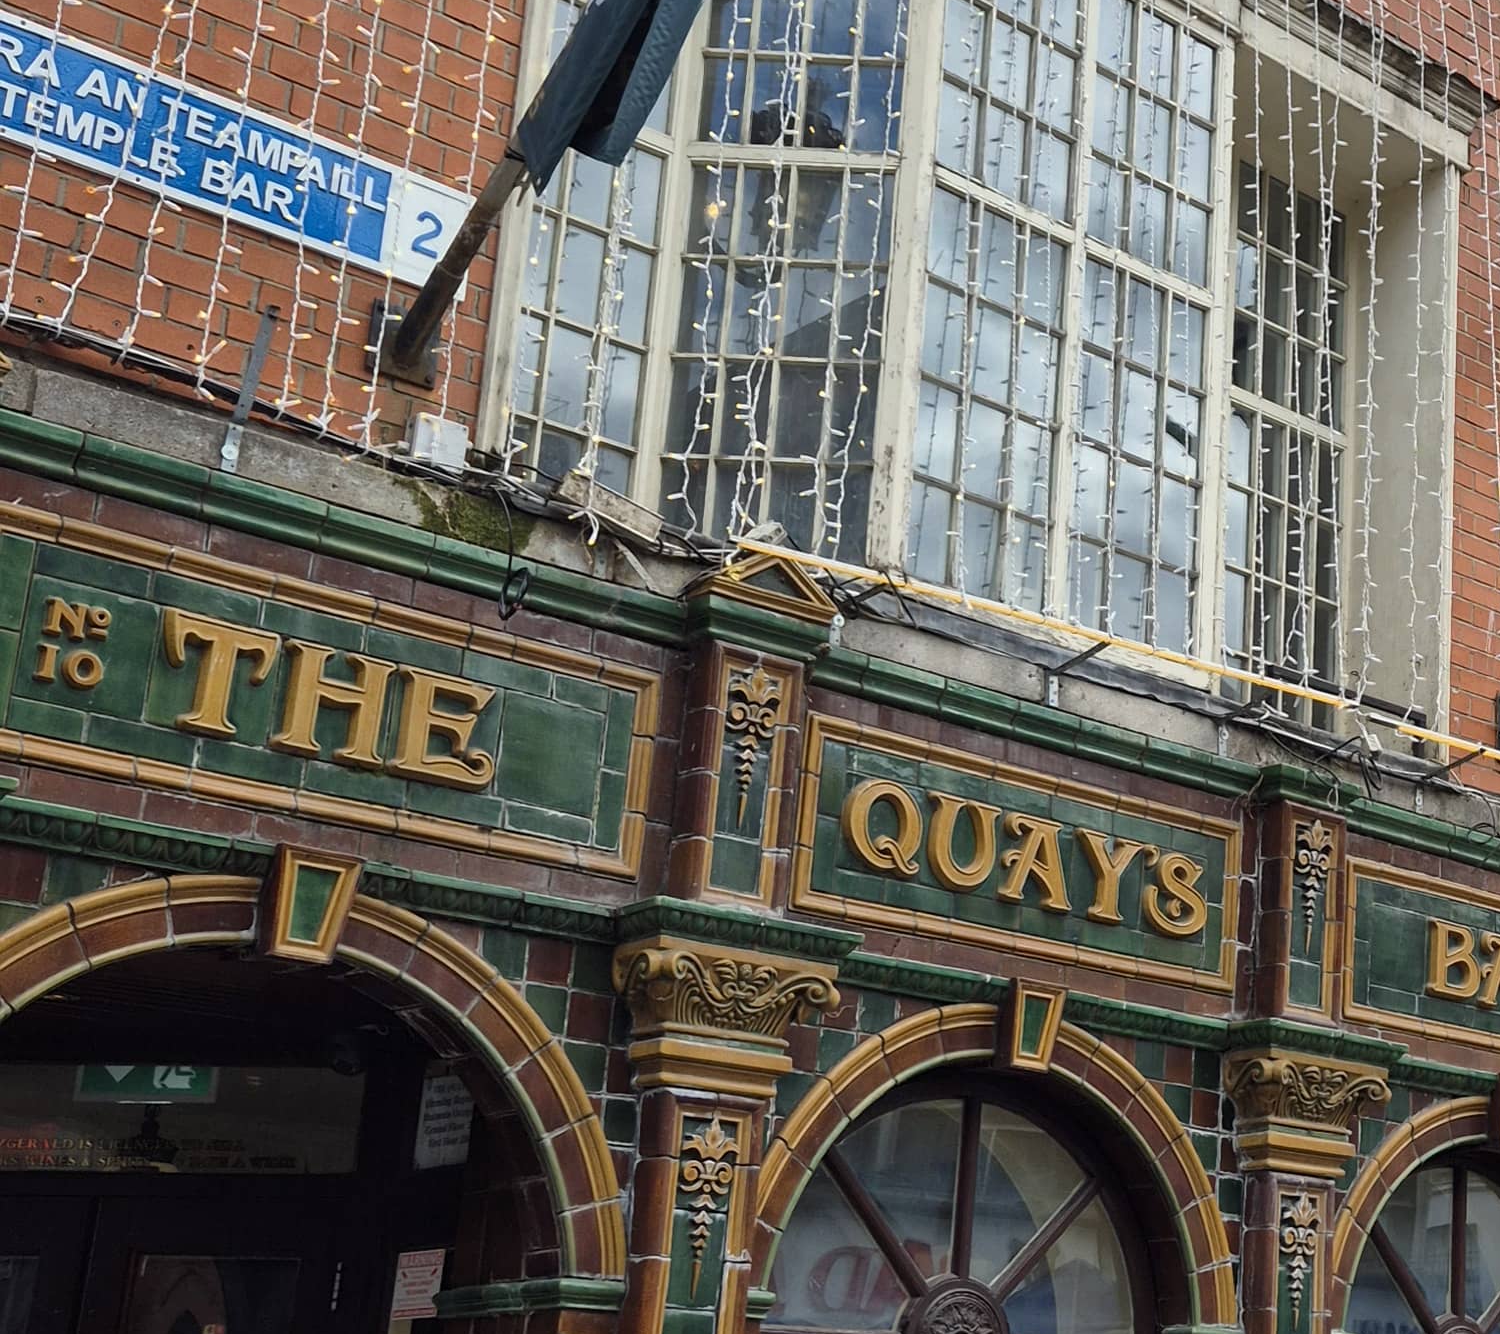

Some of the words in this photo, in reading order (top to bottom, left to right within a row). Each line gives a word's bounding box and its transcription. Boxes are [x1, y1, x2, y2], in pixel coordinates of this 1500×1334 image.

[0, 78, 184, 178] TEMPLE
[200, 156, 300, 223] BAR
[75, 68, 147, 121] AN
[160, 94, 388, 213] TEAMPAILL
[410, 209, 444, 259] 2
[32, 643, 104, 691] 10
[162, 607, 498, 793] THE
